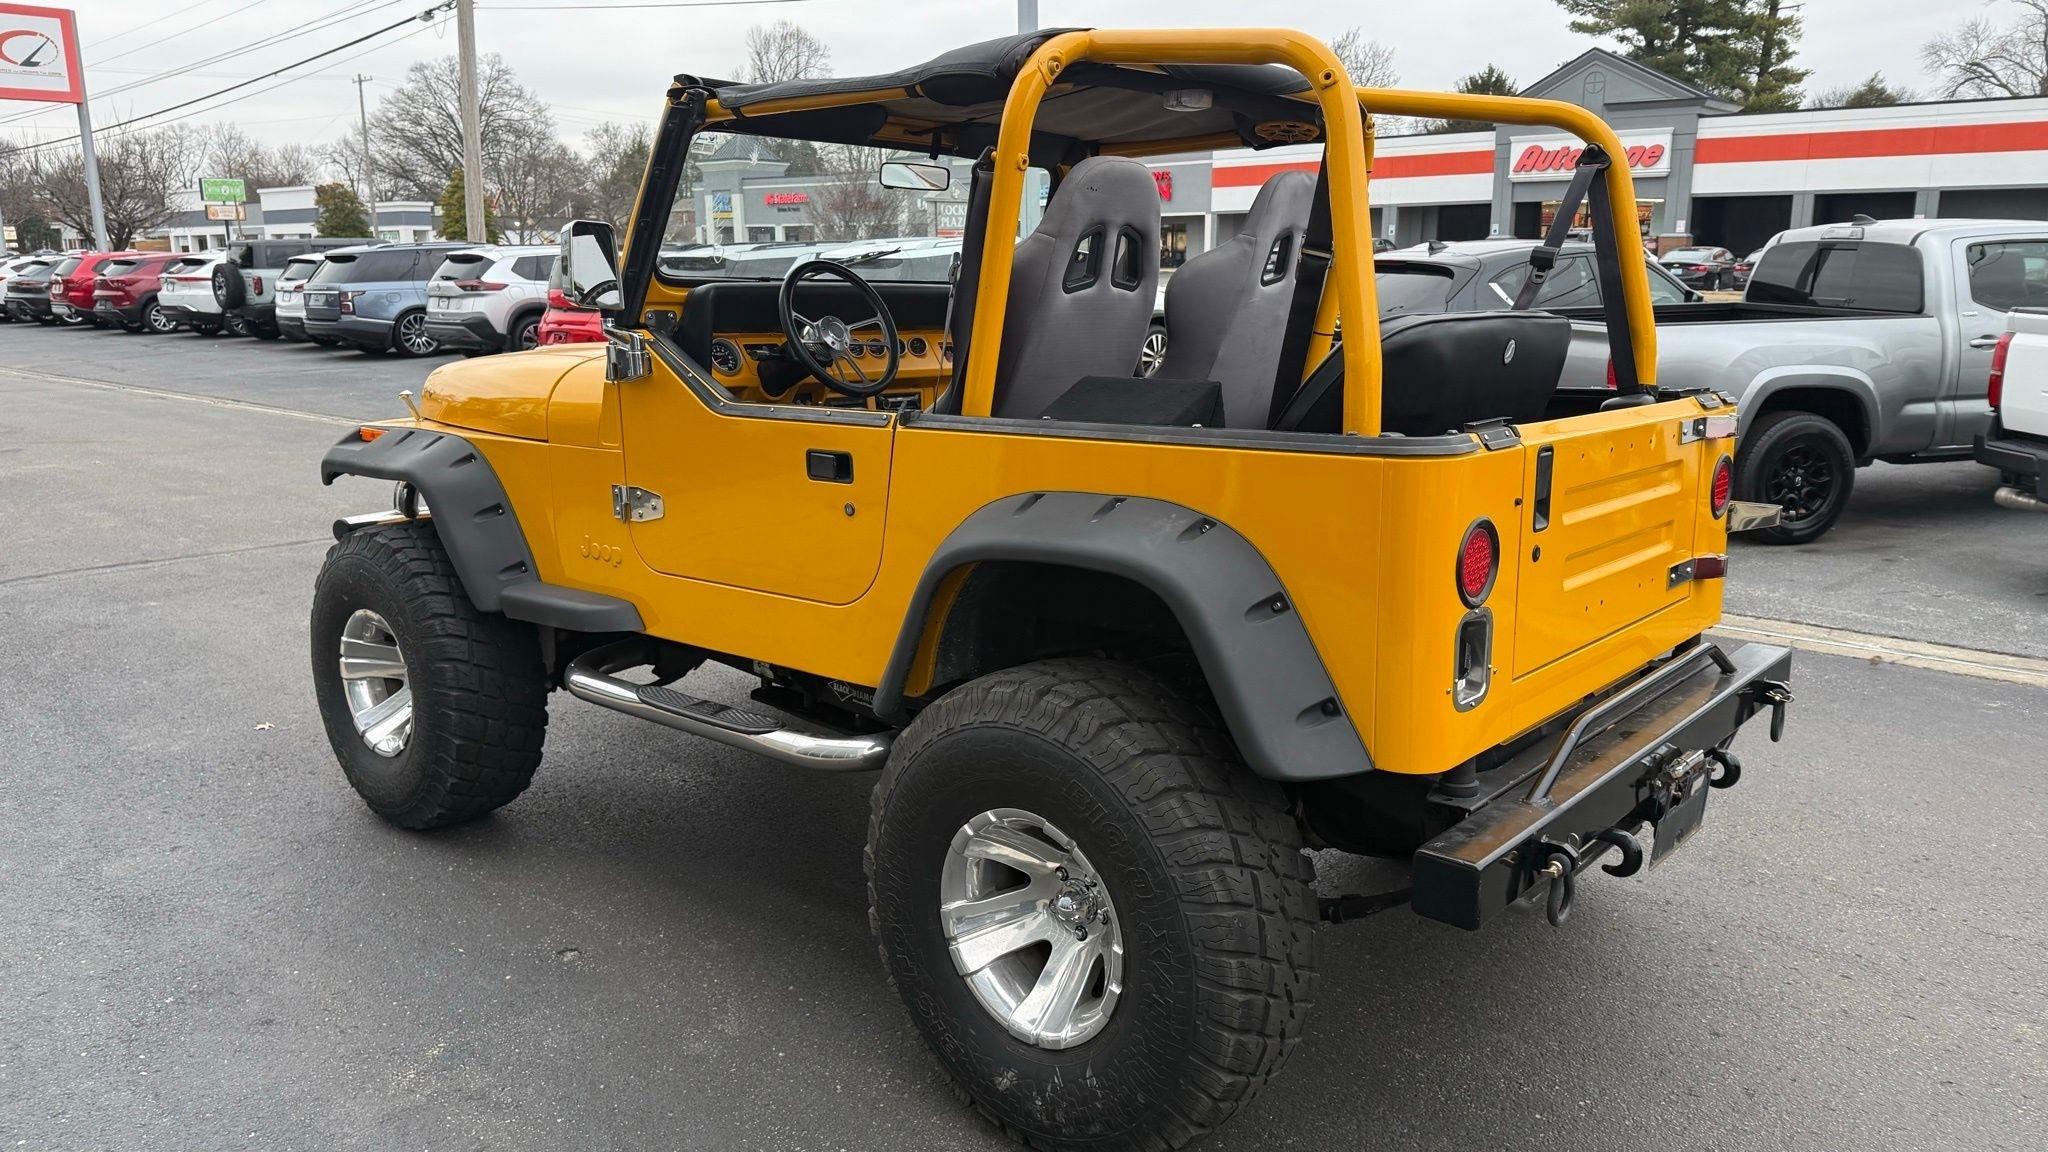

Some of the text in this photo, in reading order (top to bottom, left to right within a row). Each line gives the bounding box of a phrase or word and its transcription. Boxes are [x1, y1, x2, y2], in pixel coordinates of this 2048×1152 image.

[1513, 144, 1665, 173] Autone
[940, 204, 968, 216] LOCK
[941, 217, 967, 228] PLAZ
